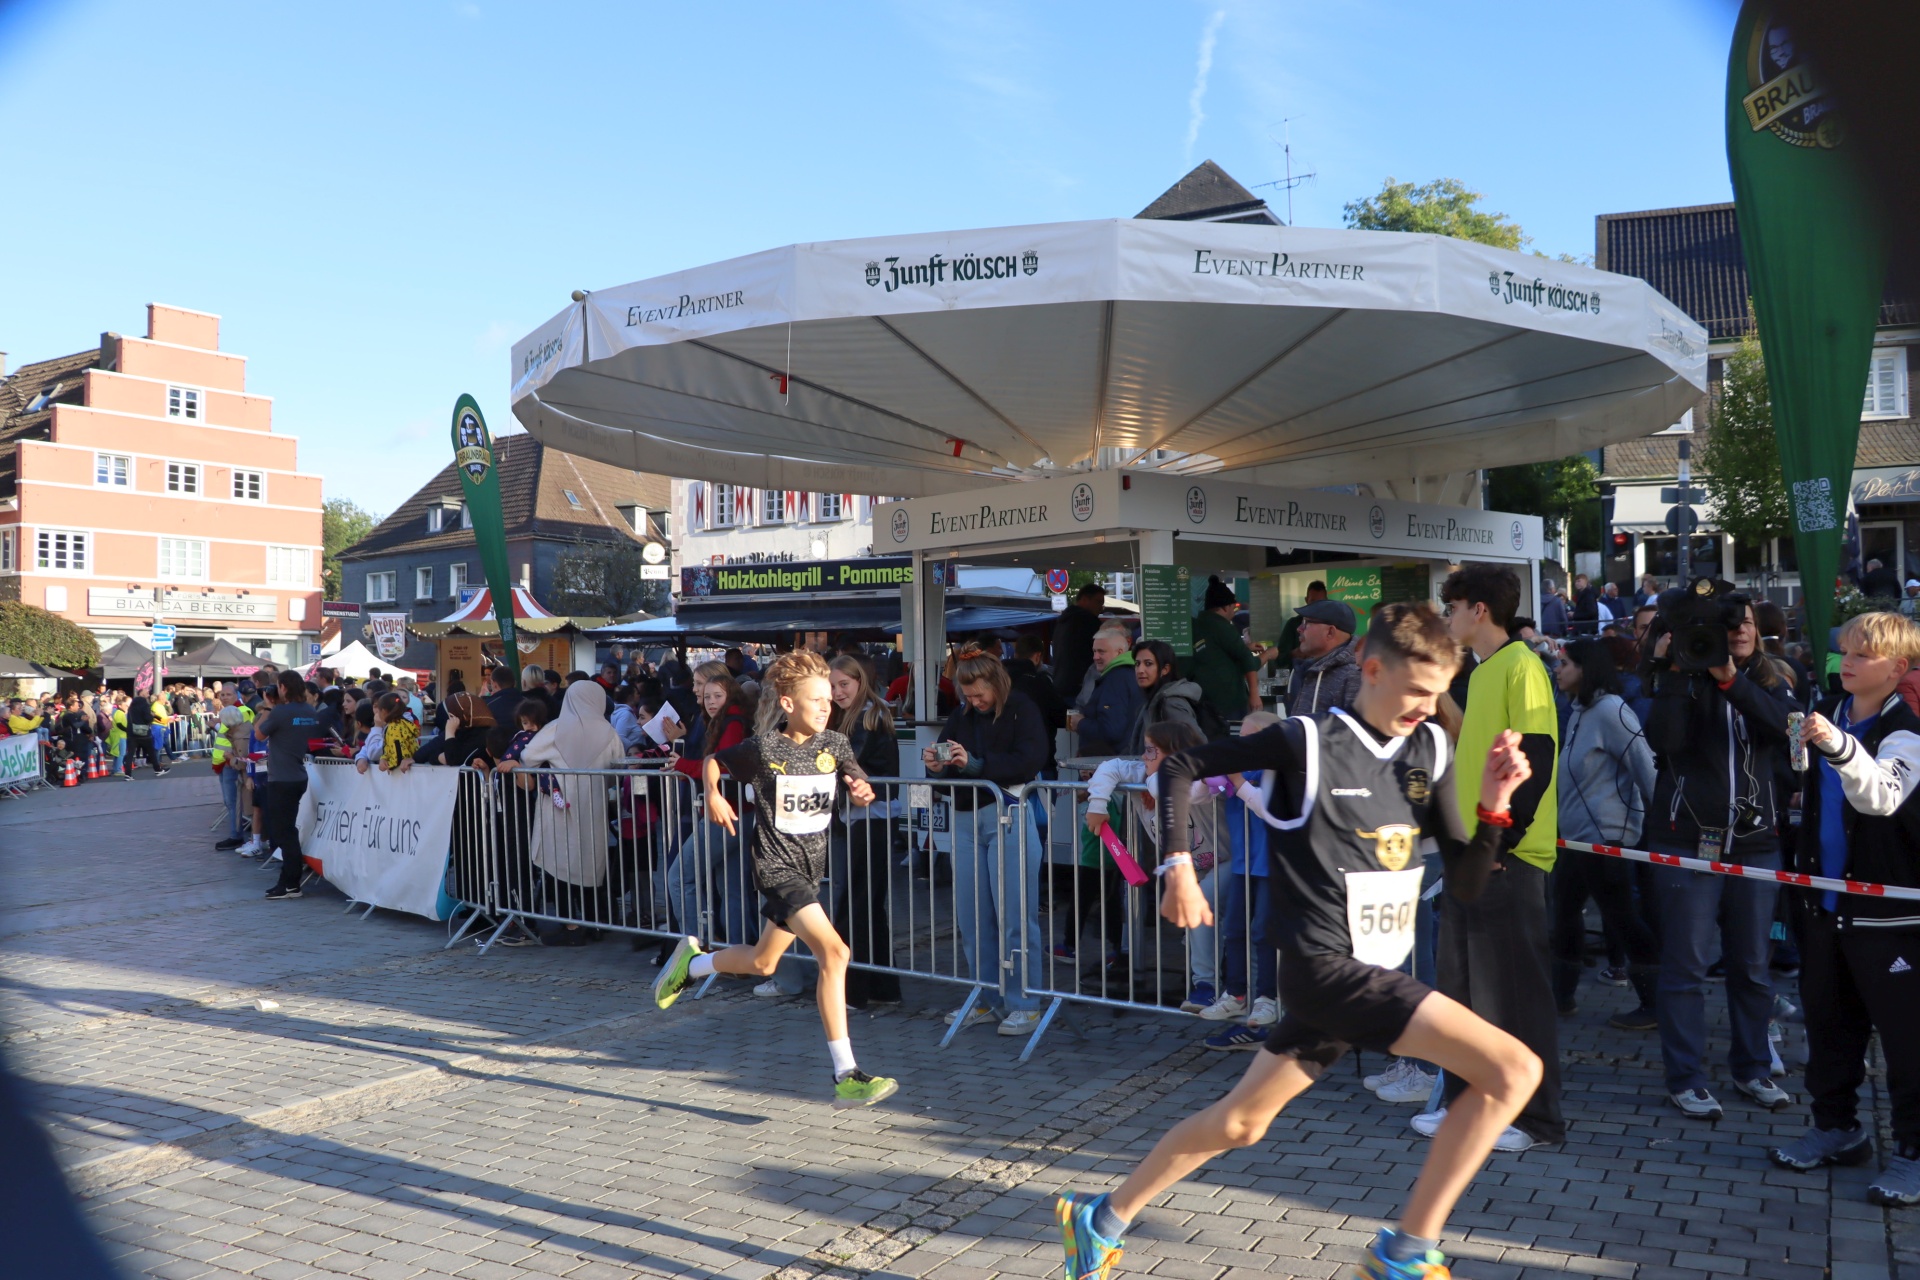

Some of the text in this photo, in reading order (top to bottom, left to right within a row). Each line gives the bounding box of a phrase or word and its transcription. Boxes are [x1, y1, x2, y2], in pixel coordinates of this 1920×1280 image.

[1752, 72, 1815, 121] BRAU
[884, 253, 1017, 292] Zunft KÖLSCH
[1503, 270, 1588, 313] Zunft KÖLSCH
[718, 567, 822, 591] Holzkohlegrill
[840, 565, 914, 585] Pommes
[1366, 574, 1382, 586] Be
[190, 602, 256, 614] BERKER
[373, 617, 404, 636] Crêpes
[312, 644, 319, 654] P
[783, 791, 830, 813] 5632
[934, 816, 943, 827] 22
